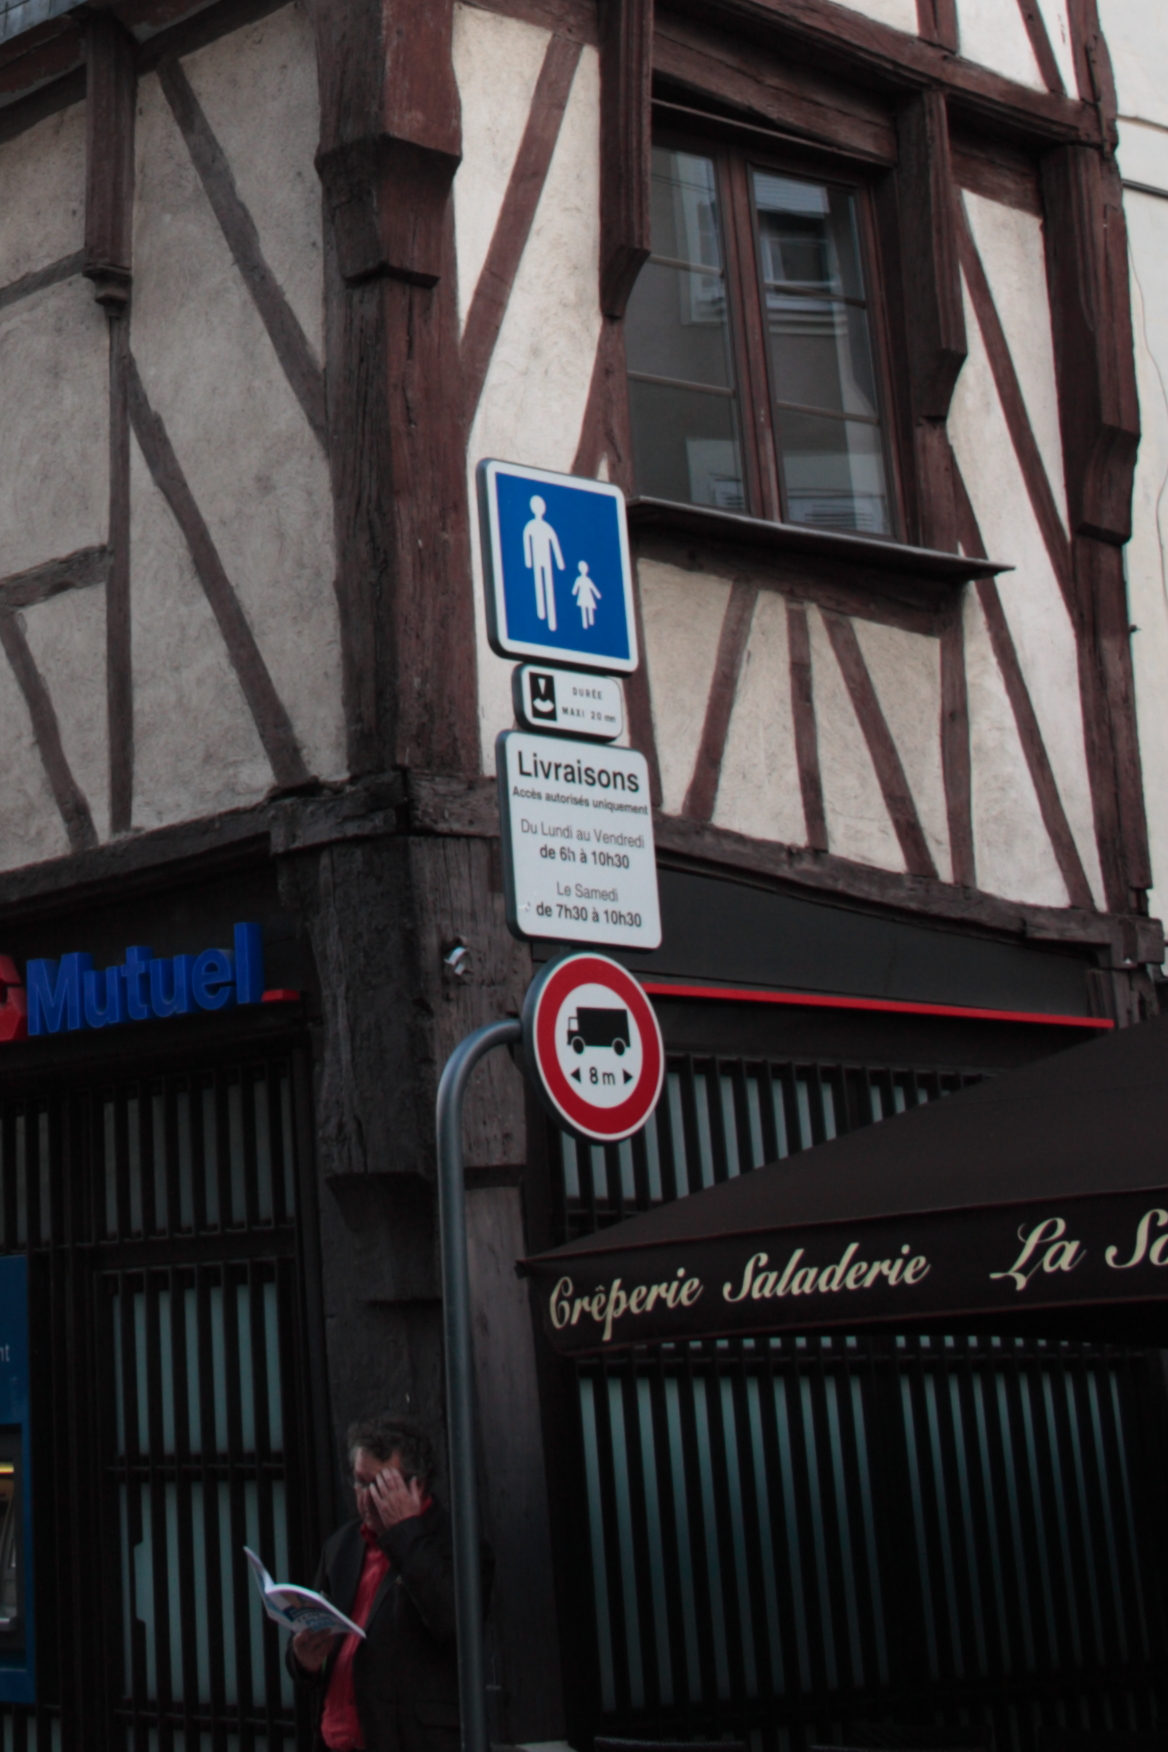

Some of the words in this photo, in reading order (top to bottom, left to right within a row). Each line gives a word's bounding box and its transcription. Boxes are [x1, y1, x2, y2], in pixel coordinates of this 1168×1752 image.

[572, 686, 603, 700] DURÉE
[562, 706, 585, 719] MAXI
[518, 750, 640, 793] Livraisons
[512, 785, 542, 800] Accès
[545, 791, 590, 808] autorisés
[592, 798, 649, 816] uniquement
[520, 818, 538, 834] Du
[540, 821, 573, 840] Lundi
[576, 831, 590, 842] au
[593, 828, 645, 849] Vendredi
[539, 844, 556, 859] de
[559, 846, 576, 862] 6h
[579, 848, 587, 864] à
[591, 851, 630, 869] 10h30
[556, 881, 571, 897] Le
[574, 883, 619, 902] Samedi
[536, 901, 553, 917] de
[555, 903, 588, 921] 7h30
[591, 907, 599, 923] à
[603, 910, 642, 927] 10h30
[26, 921, 265, 1036] Mutuel
[548, 1266, 703, 1342] Crêperie
[722, 1242, 930, 1303] Saladerie
[989, 1216, 1088, 1292] La
